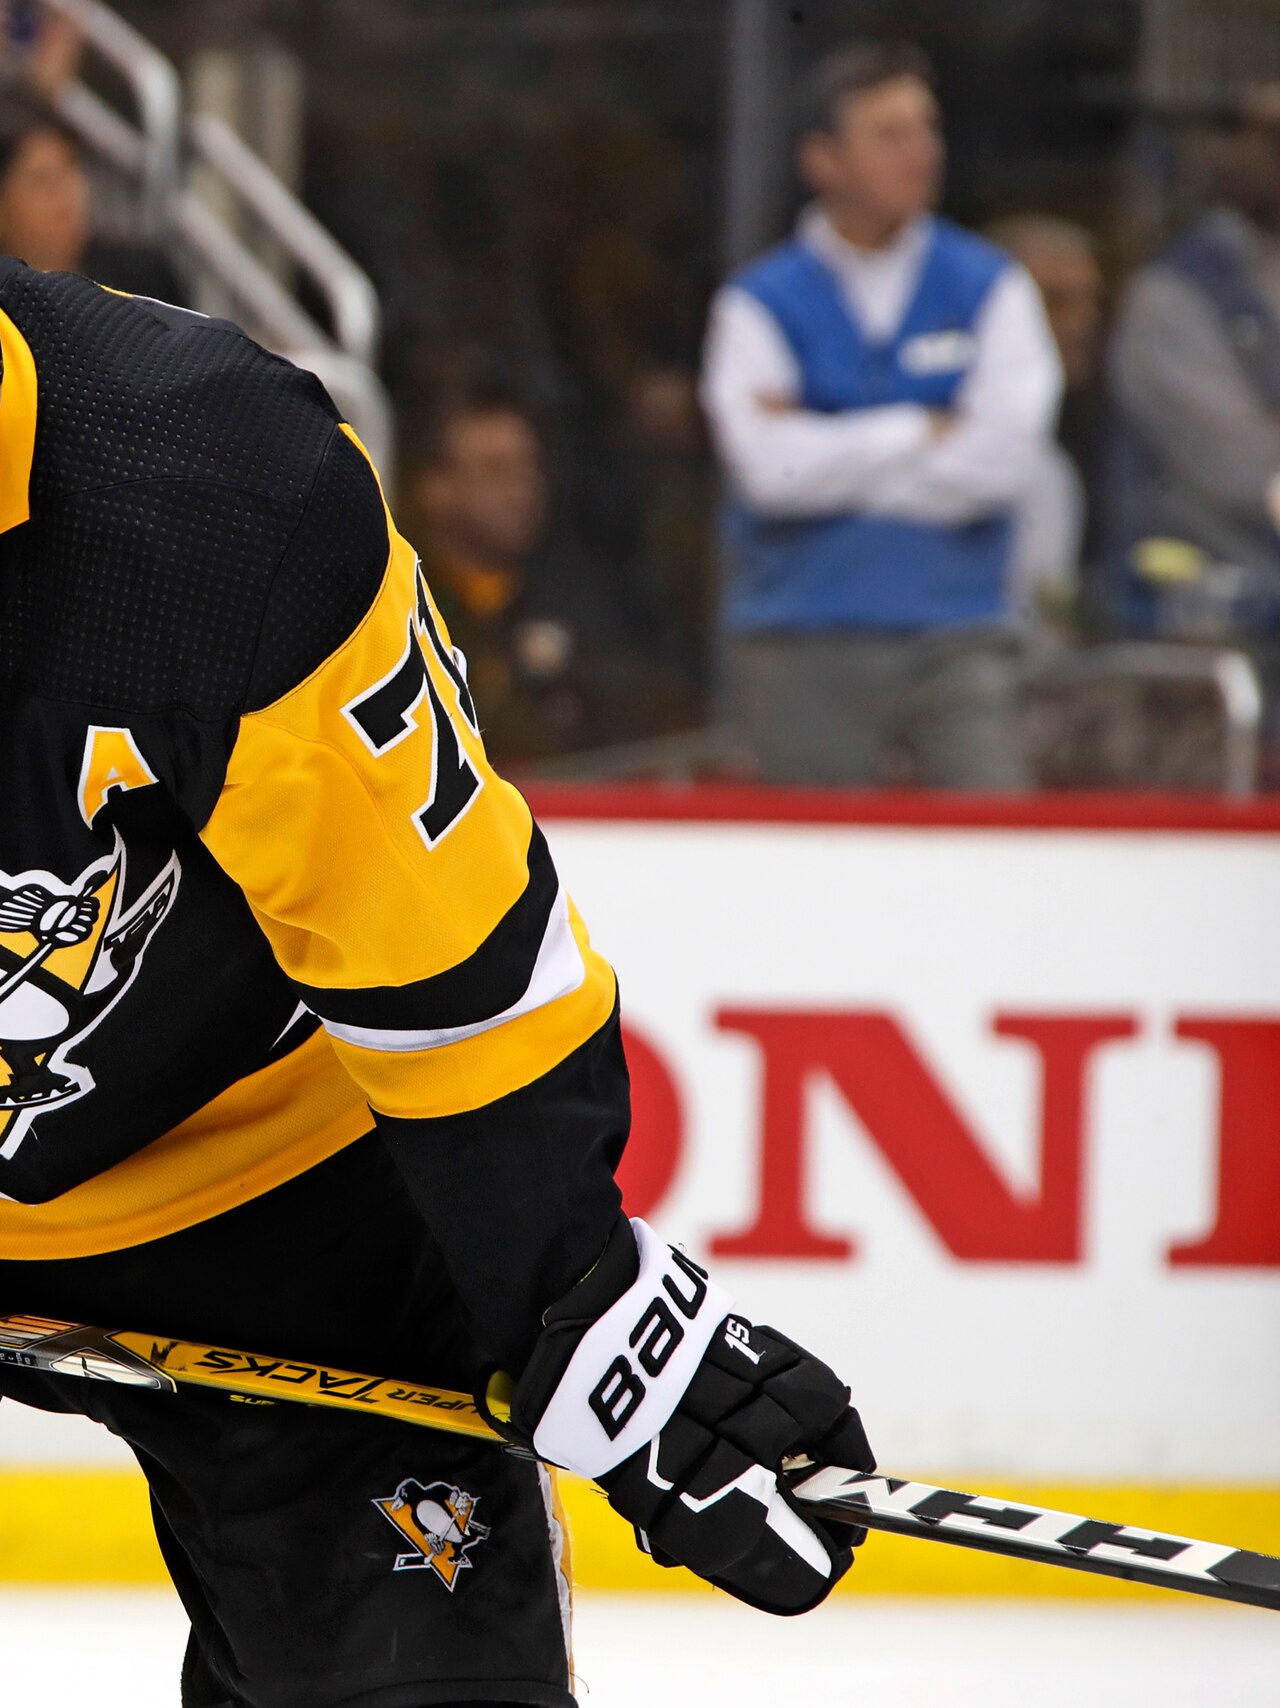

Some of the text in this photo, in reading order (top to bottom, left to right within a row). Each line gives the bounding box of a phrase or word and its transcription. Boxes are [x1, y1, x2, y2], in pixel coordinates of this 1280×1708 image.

[77, 725, 159, 830] A
[192, 1349, 482, 1415] UPER TACKS
[588, 1243, 709, 1442] BAU
[791, 1465, 1241, 1582] CCM
